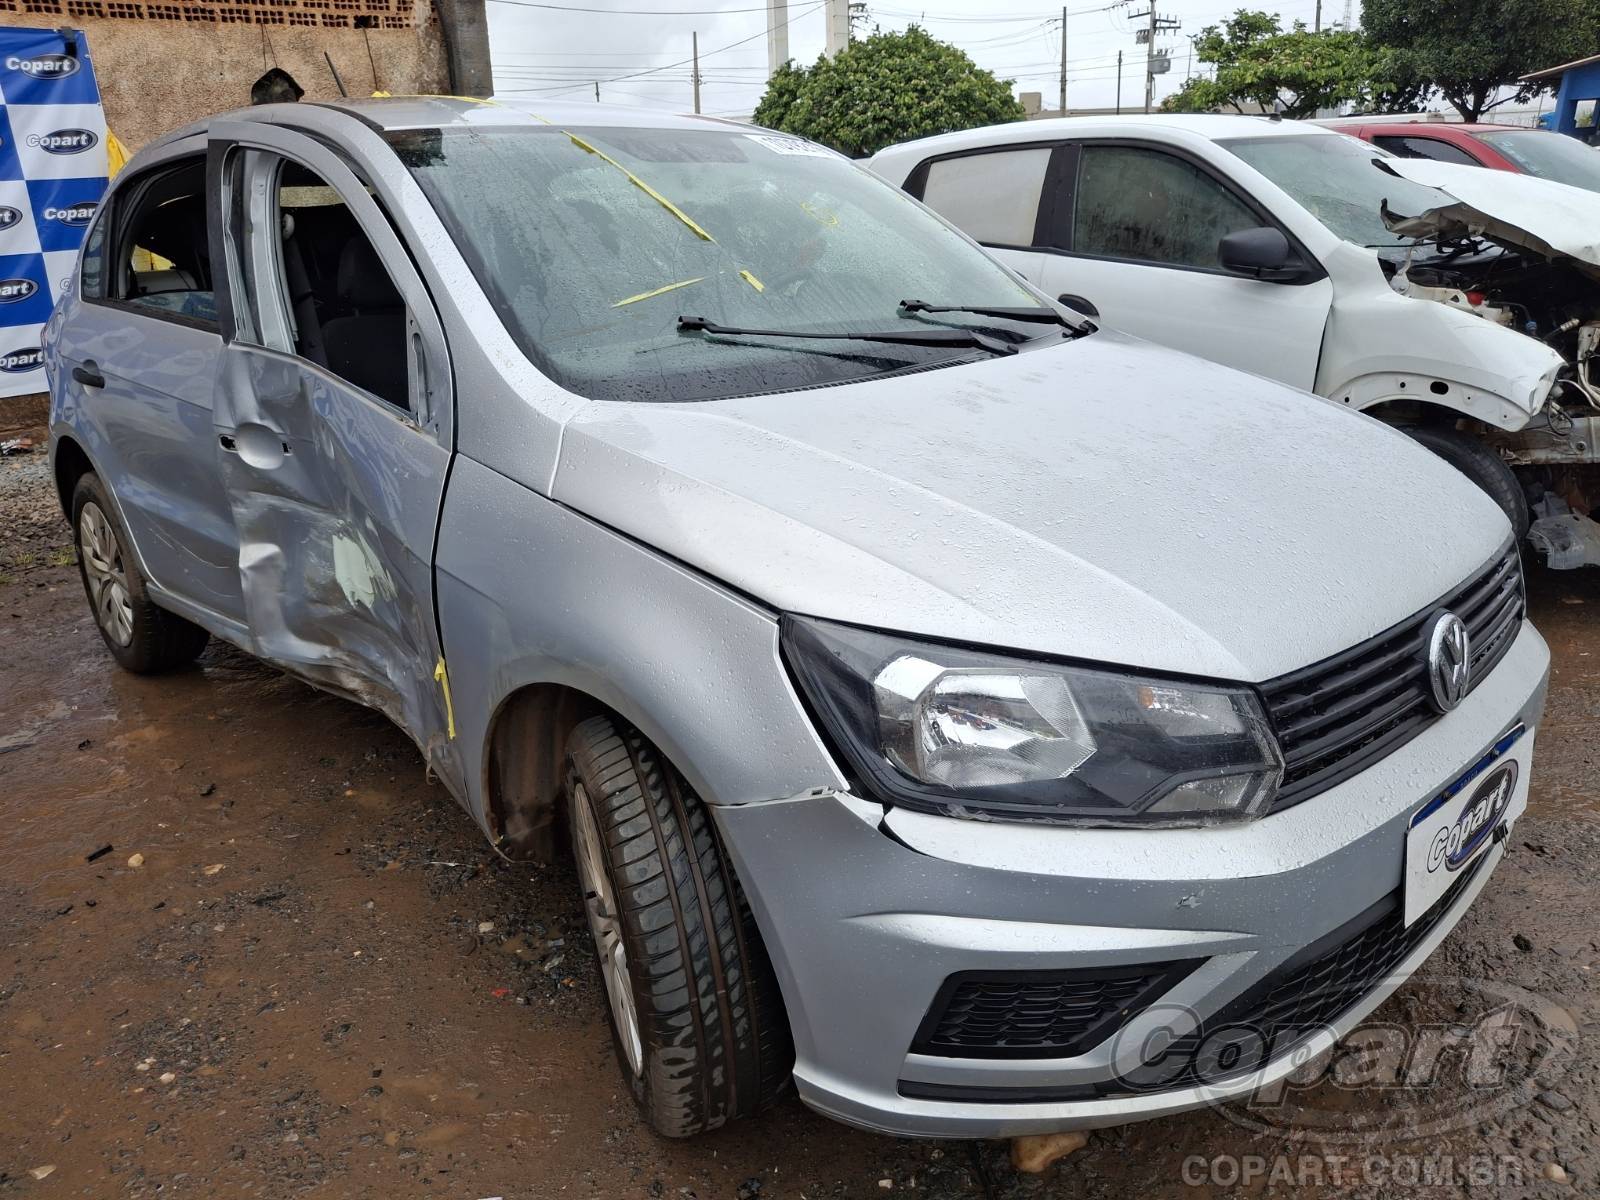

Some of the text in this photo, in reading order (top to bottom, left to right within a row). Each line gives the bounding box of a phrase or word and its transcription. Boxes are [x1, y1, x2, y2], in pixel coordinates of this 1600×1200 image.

[5, 56, 72, 74] Copart
[26, 133, 88, 149] Copart
[44, 206, 97, 222] Copar
[0, 350, 45, 369] opart
[1426, 767, 1511, 873] Copart
